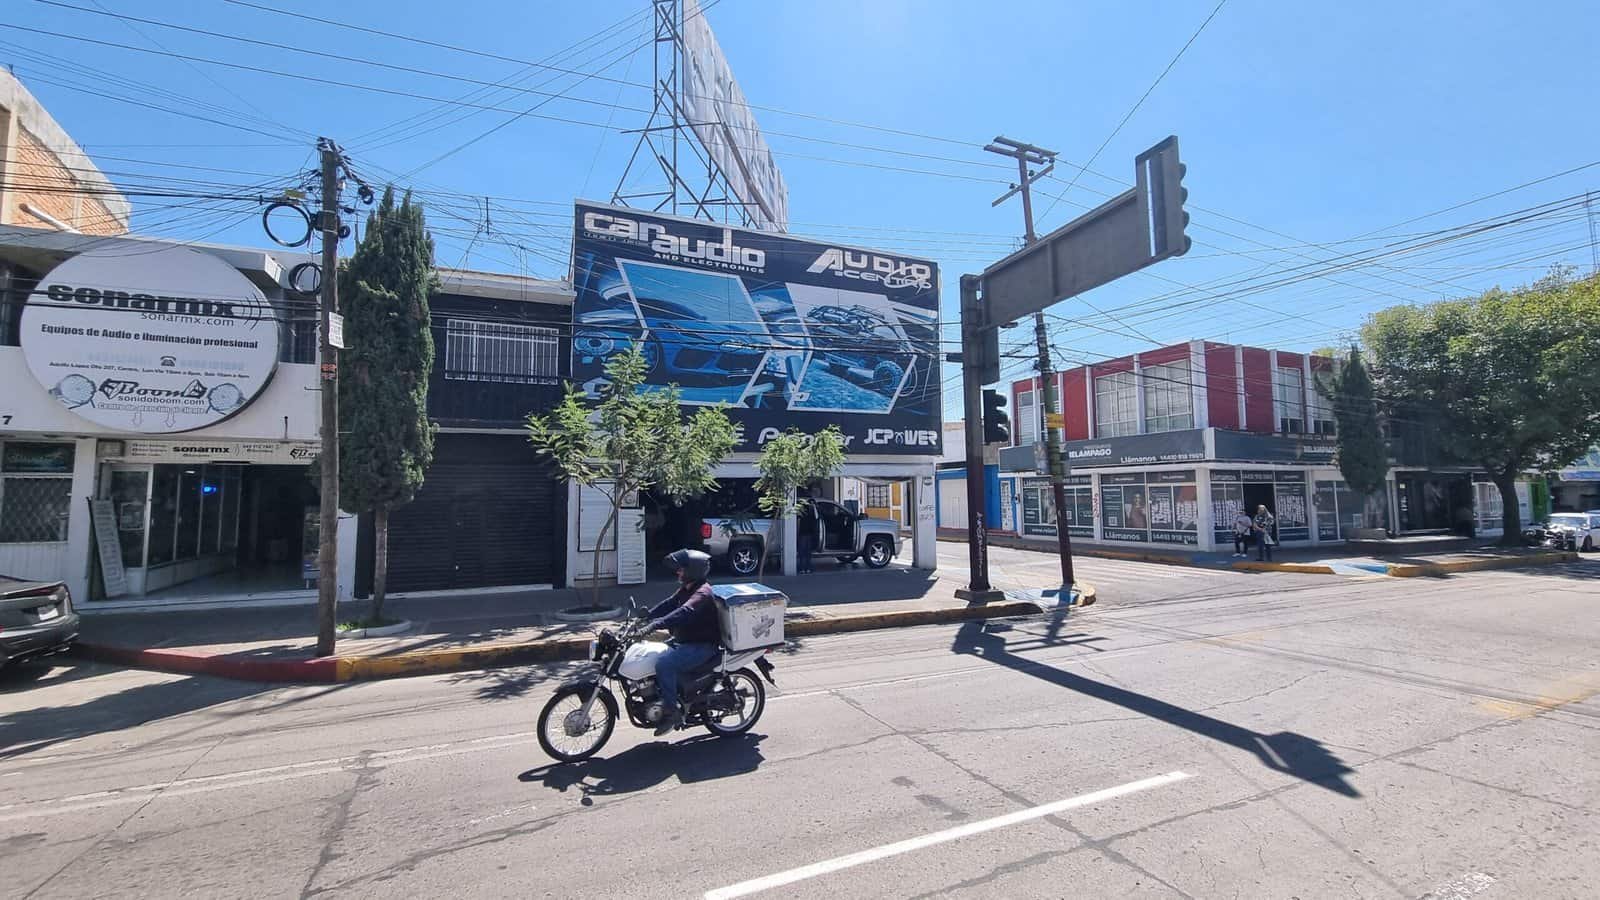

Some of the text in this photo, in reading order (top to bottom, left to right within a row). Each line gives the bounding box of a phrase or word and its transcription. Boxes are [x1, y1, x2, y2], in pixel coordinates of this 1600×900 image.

[584, 212, 666, 246] car
[652, 228, 766, 268] audio
[654, 253, 766, 274] AND ELECTRONICS
[806, 248, 932, 279] AUDIO
[48, 284, 234, 317] sonarmx
[141, 312, 234, 327] sonarmx.com
[41, 323, 84, 336] Equipos
[86, 328, 100, 337] de
[102, 329, 132, 340] Audio
[204, 338, 258, 349] profesional
[2, 415, 13, 425] 7
[173, 446, 230, 454] sonarmx
